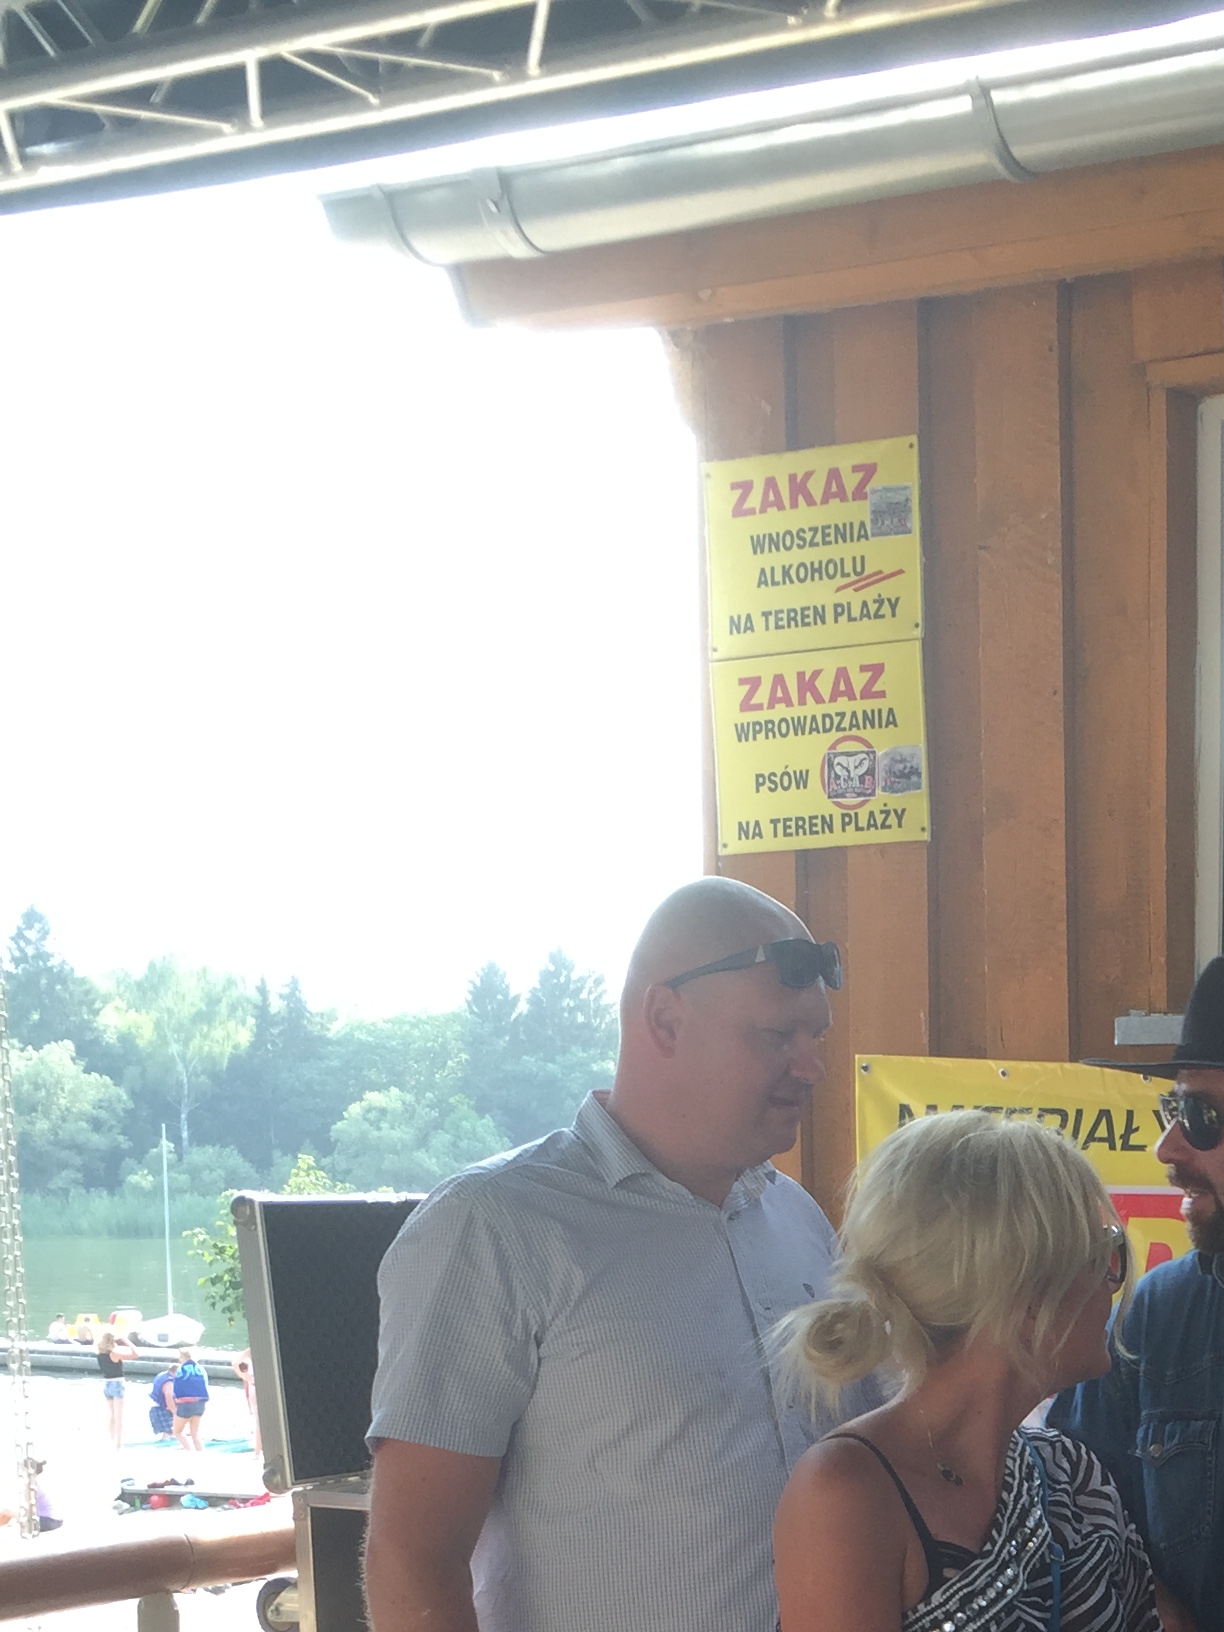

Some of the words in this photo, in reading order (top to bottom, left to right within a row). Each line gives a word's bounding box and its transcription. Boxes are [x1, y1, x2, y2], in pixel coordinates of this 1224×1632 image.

[730, 462, 878, 518] ZAKAZ
[750, 521, 870, 556] WNOSZENIA
[757, 555, 866, 588] ALKOHOLU
[729, 613, 755, 636] NA
[761, 604, 826, 632] TEREN
[833, 593, 901, 624] PLAŻY
[738, 662, 887, 713] ZAKAZ
[734, 707, 898, 743] WPROWADZANIA
[755, 765, 810, 793] PSÓW
[737, 819, 763, 841] NA
[770, 813, 834, 838] TEREN
[841, 802, 907, 833] PLAŻY
